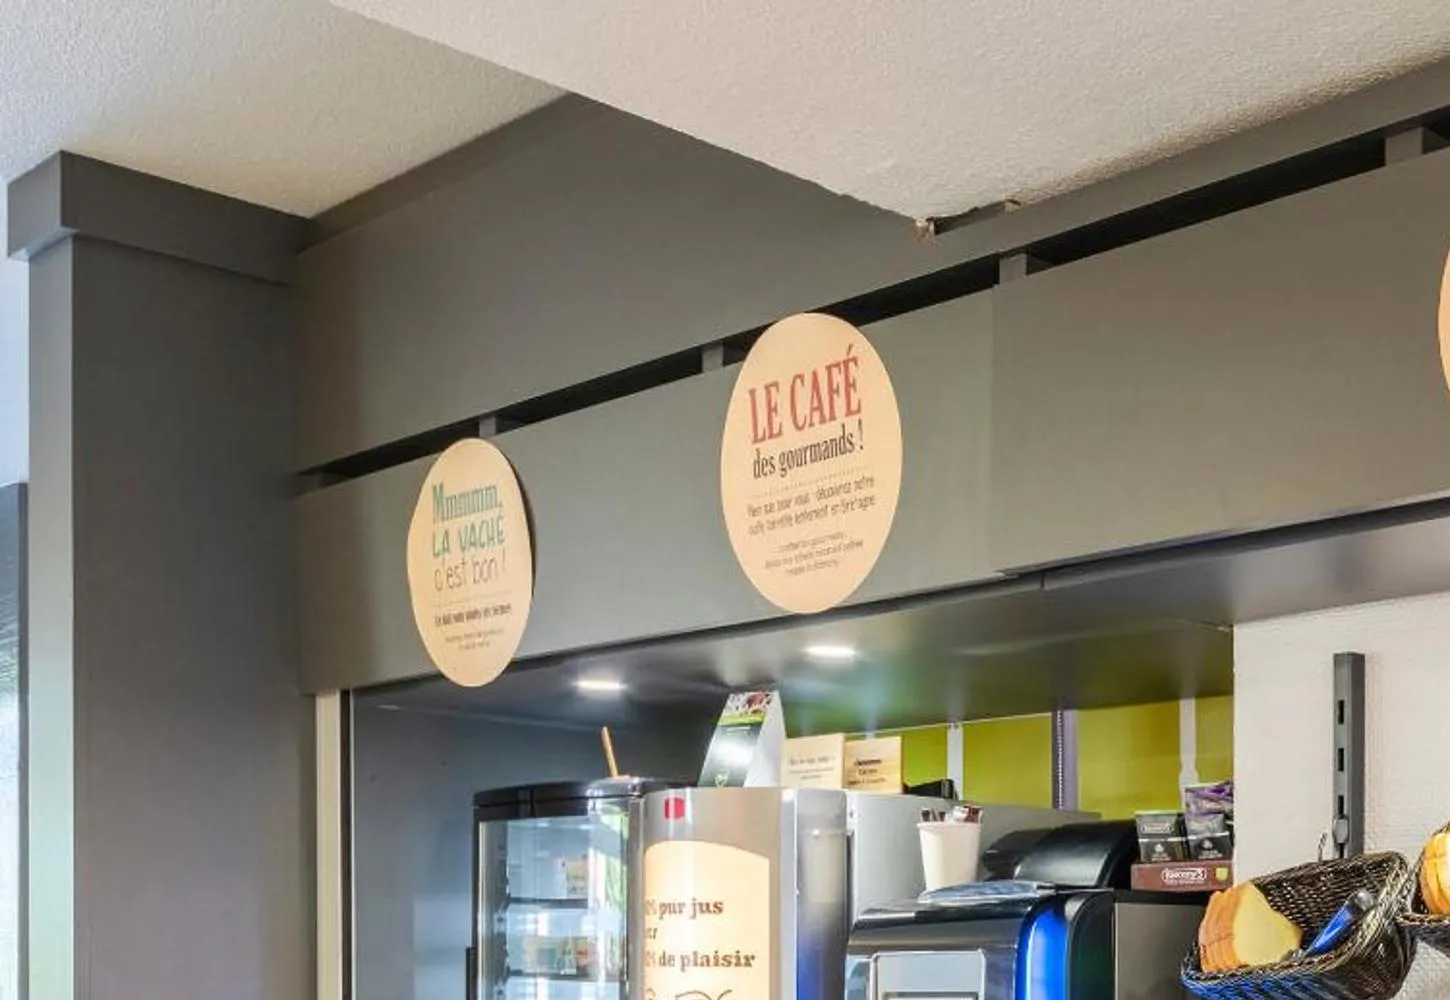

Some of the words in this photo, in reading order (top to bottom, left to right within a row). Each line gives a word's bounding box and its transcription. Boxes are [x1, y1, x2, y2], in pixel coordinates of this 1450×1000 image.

[748, 381, 783, 445] LE
[789, 343, 862, 432] CAFÉ
[753, 447, 776, 479] des
[778, 422, 855, 478] gourmands
[857, 418, 864, 450] !
[432, 529, 451, 557] LA
[458, 515, 506, 552] VACHE
[472, 556, 498, 586] bon
[659, 901, 686, 920] pur
[689, 897, 724, 920] jus
[659, 949, 675, 967] de
[680, 949, 756, 973] plaisir
